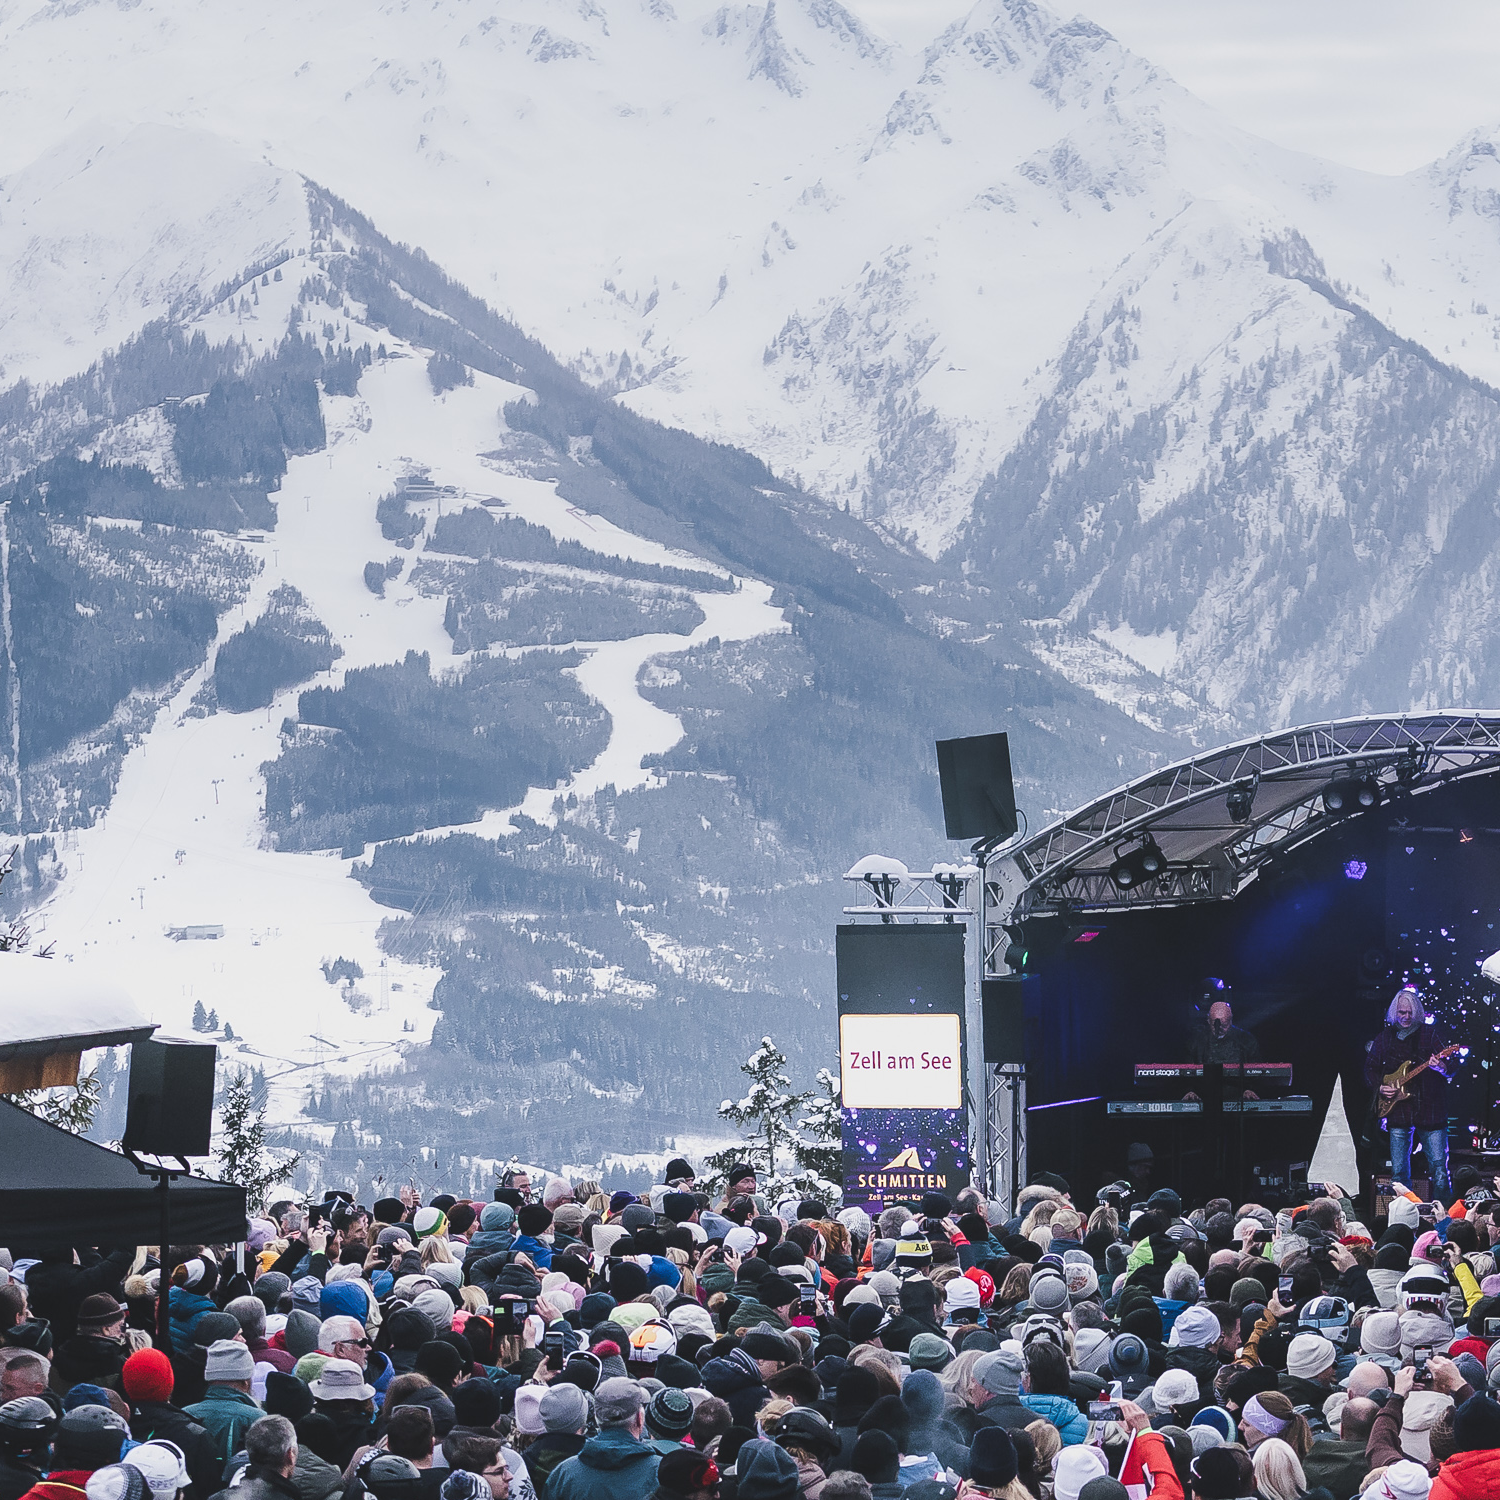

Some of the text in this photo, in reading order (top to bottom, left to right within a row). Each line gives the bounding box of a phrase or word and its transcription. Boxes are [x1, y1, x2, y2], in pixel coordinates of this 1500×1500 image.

[850, 1050, 952, 1070] Zell am See
[1148, 1103, 1173, 1112] KORG
[858, 1174, 947, 1188] SCHMITTEN
[914, 1243, 930, 1252] ÅRE
